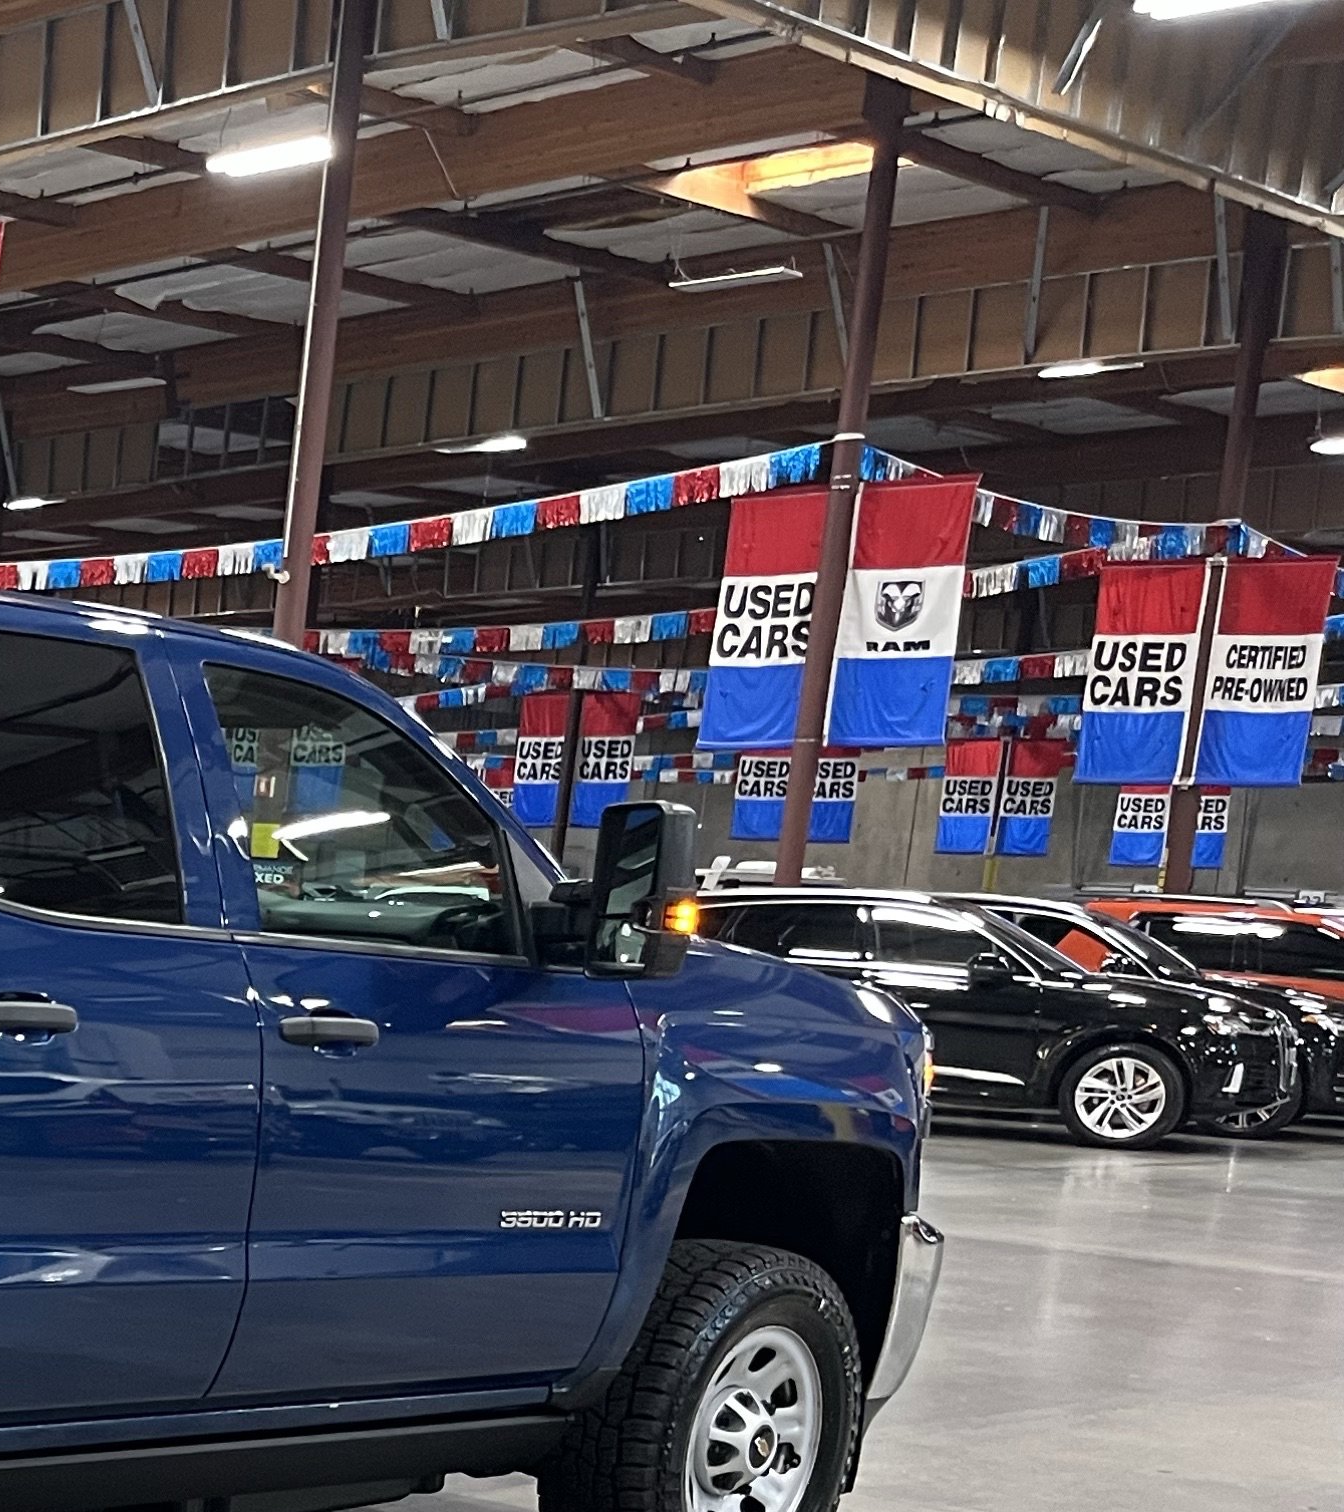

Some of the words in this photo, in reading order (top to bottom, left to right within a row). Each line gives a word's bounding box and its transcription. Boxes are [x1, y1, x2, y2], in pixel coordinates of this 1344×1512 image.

[723, 582, 816, 620] USED
[716, 623, 811, 659] CARS
[866, 640, 930, 652] RAM
[1093, 641, 1187, 673] USED
[1226, 644, 1307, 670] CERTIFIED
[1089, 675, 1183, 706] CARS
[1211, 677, 1308, 702] PRE-OWNED
[235, 728, 256, 743] US
[234, 744, 255, 763] CA
[293, 744, 343, 763] CARS
[581, 740, 632, 759] USED
[516, 762, 562, 780] CARS
[579, 761, 630, 780] CARS
[741, 760, 790, 779] USED
[818, 761, 856, 779] SED
[738, 779, 787, 797] CARS
[814, 781, 855, 799] ARS
[945, 779, 993, 796] USED
[1006, 780, 1054, 797] USED
[942, 798, 990, 814] CARS
[1003, 798, 1051, 815] CARS
[1120, 797, 1165, 813] USED
[1202, 799, 1227, 814] ED
[1117, 814, 1164, 830] CARS
[1200, 815, 1225, 831] RS
[254, 872, 285, 885] XED
[500, 1211, 564, 1228] 3500
[568, 1211, 602, 1228] HD
